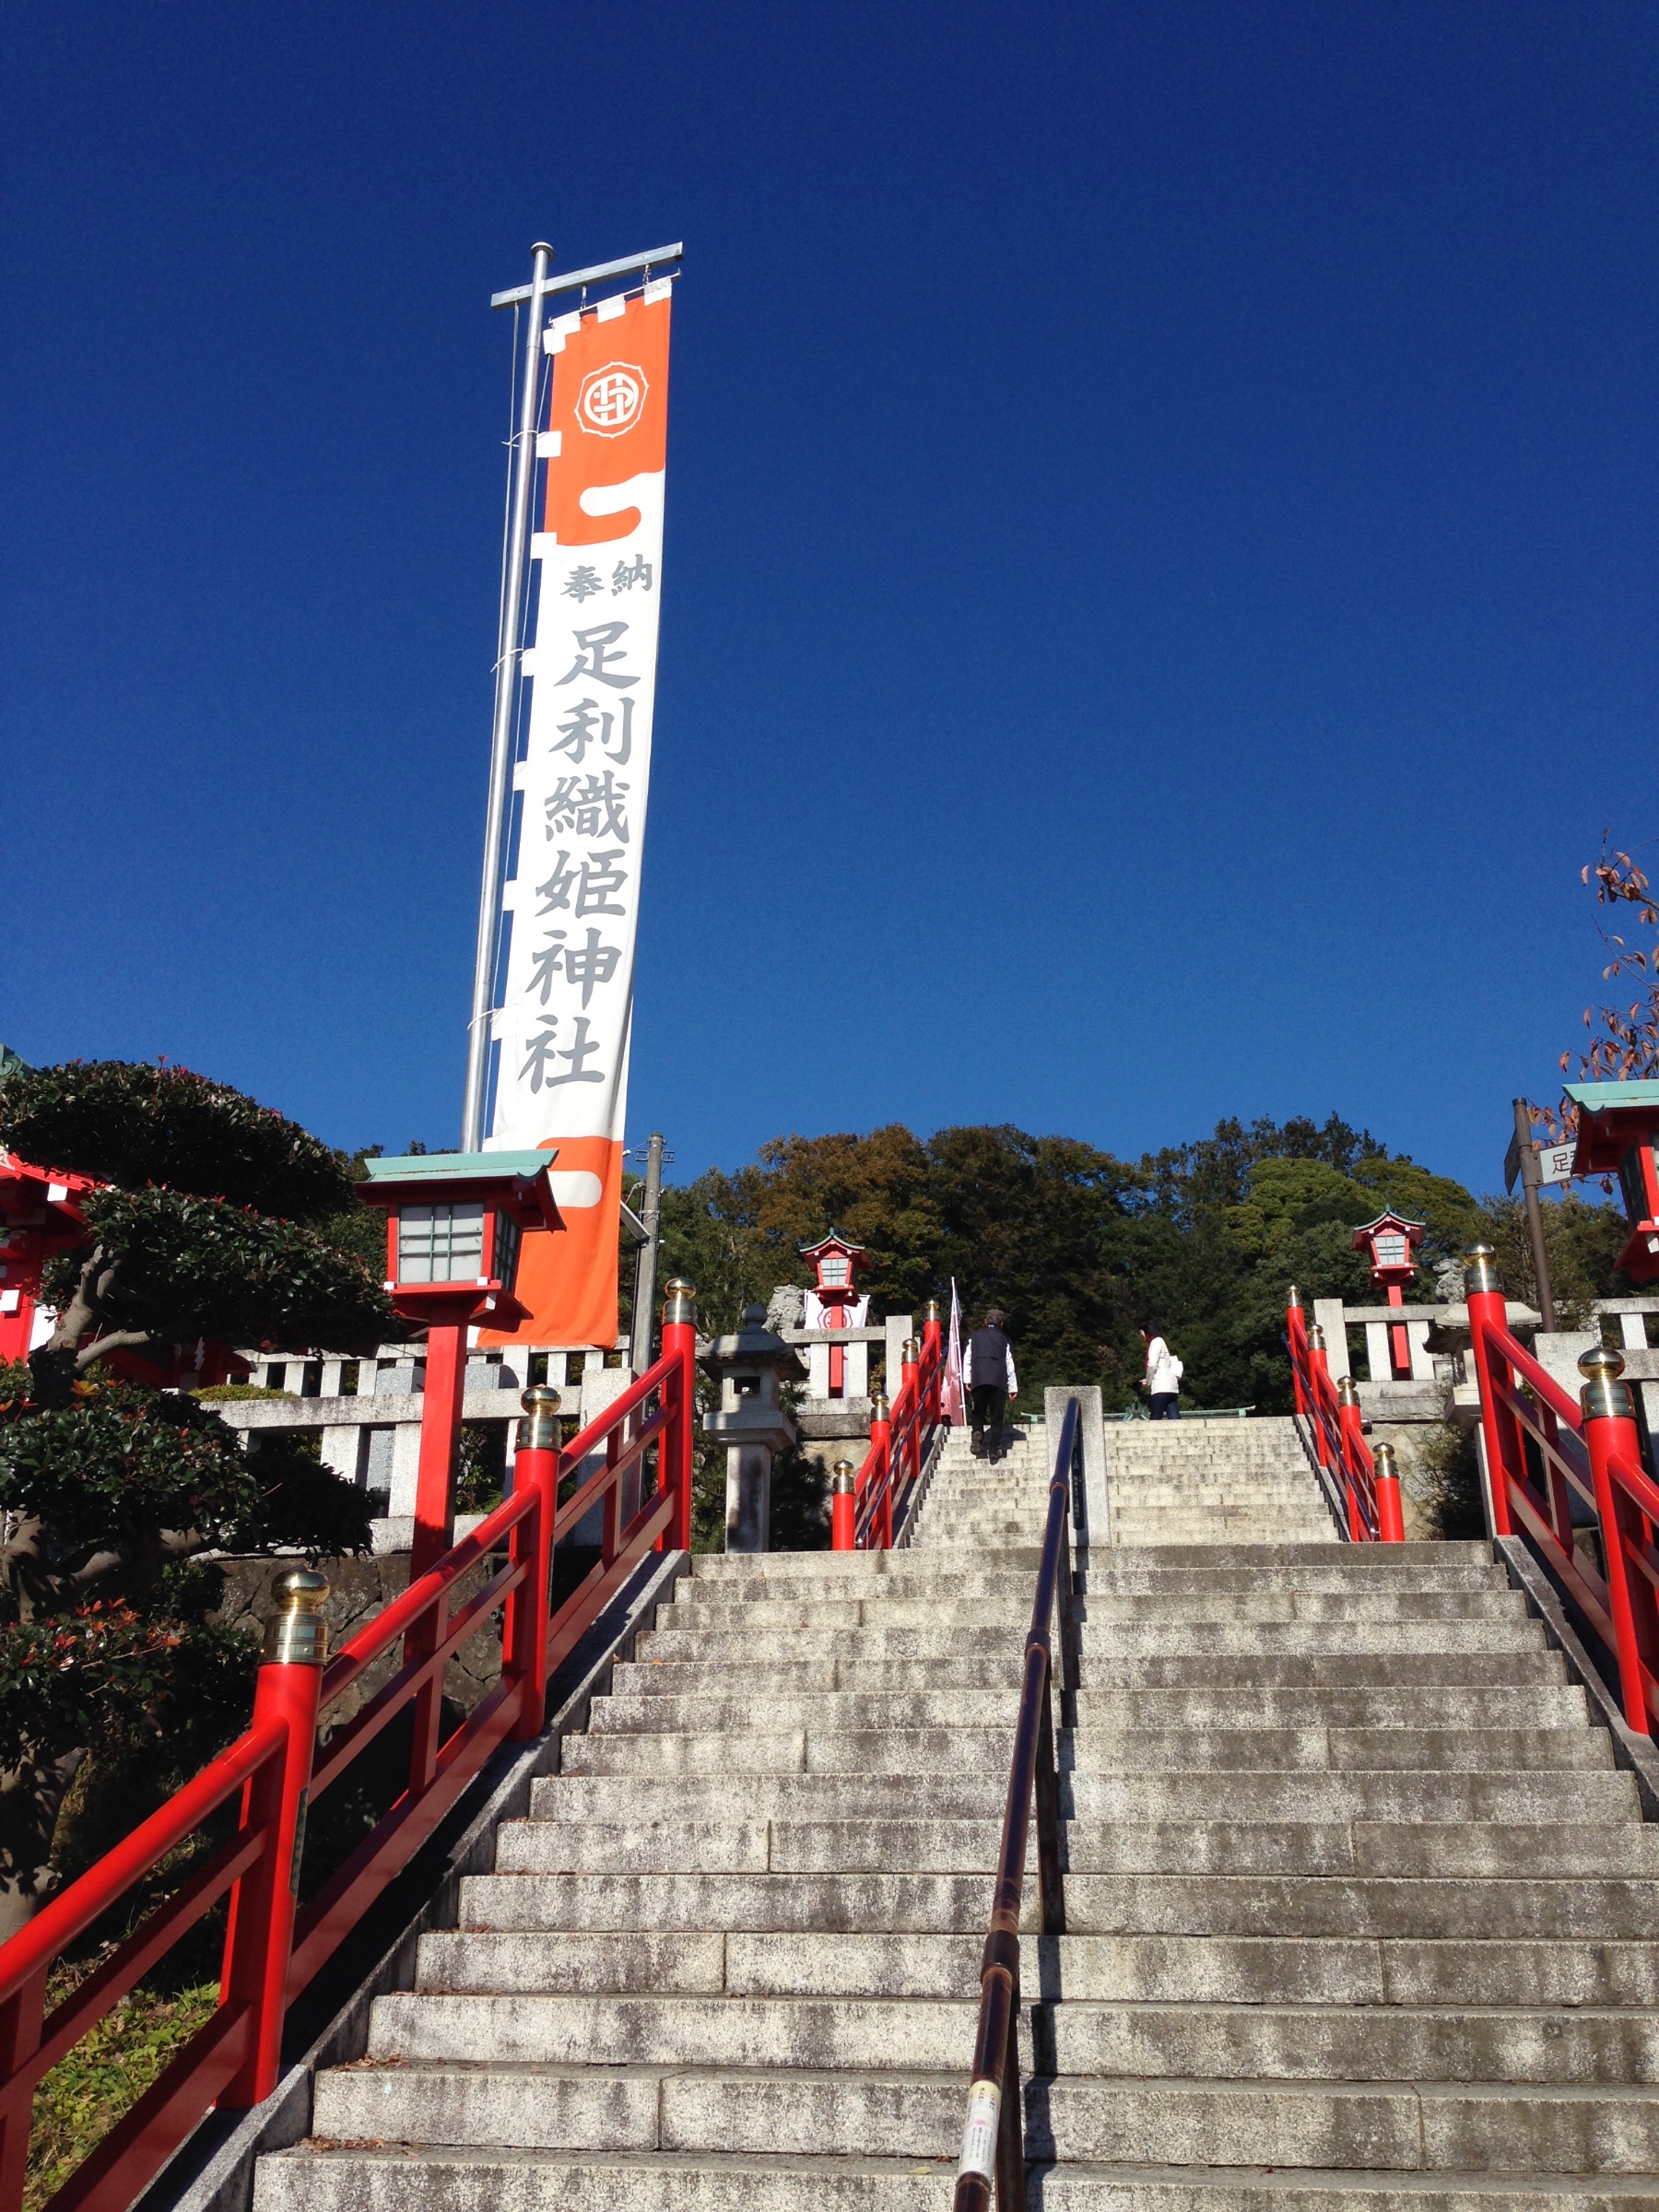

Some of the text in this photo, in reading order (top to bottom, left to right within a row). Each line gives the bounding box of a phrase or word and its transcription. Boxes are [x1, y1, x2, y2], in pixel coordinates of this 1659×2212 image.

[559, 553, 653, 604] 奉納
[518, 621, 641, 1095] 足利織姫神社
